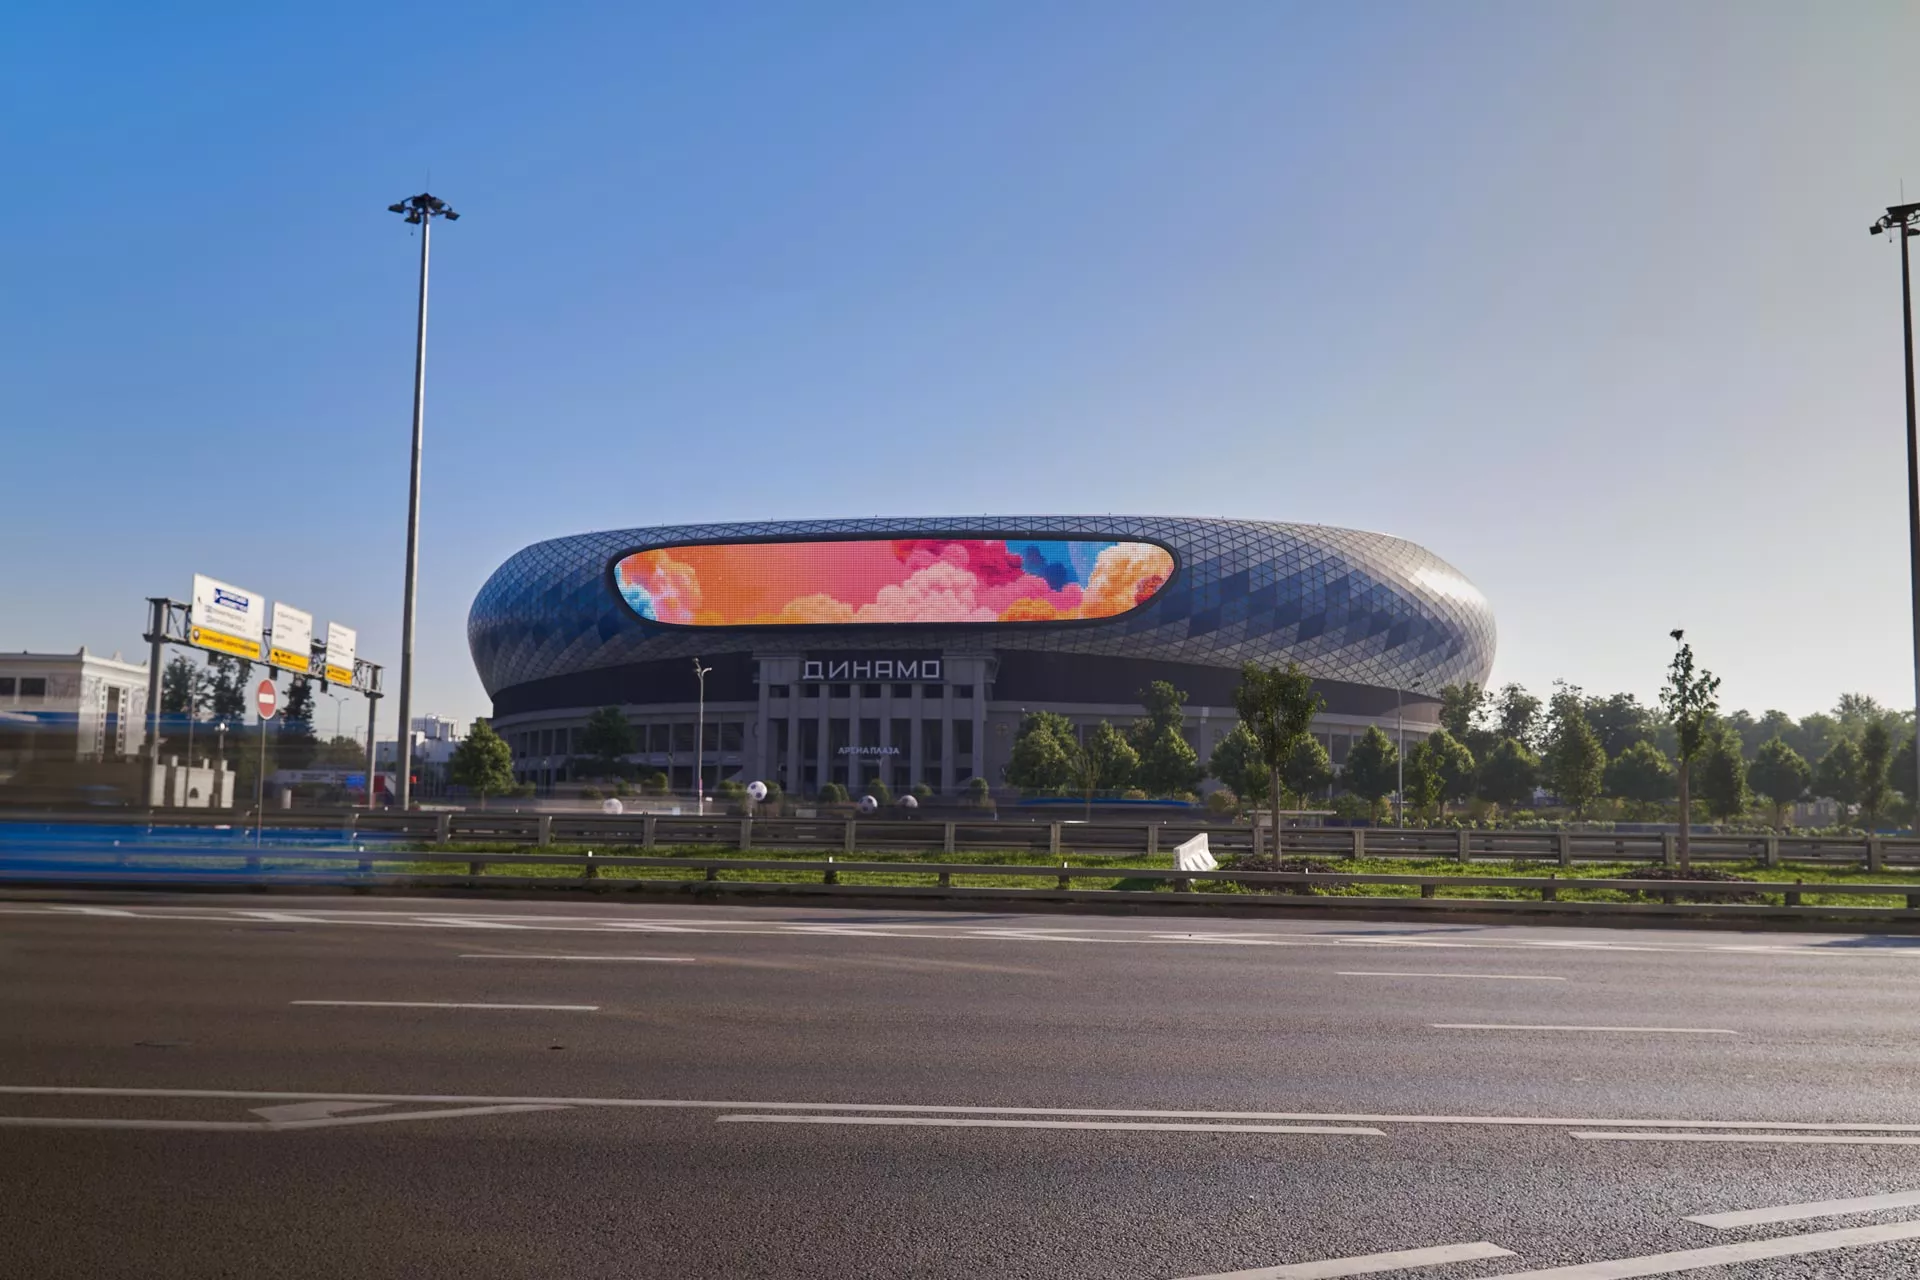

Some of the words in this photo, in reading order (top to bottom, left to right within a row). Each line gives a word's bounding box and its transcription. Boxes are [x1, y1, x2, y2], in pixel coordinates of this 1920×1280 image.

[803, 660, 940, 679] ДИНАМО
[837, 746, 869, 755] АРЕНА
[870, 746, 900, 755] ПЛАЗА
